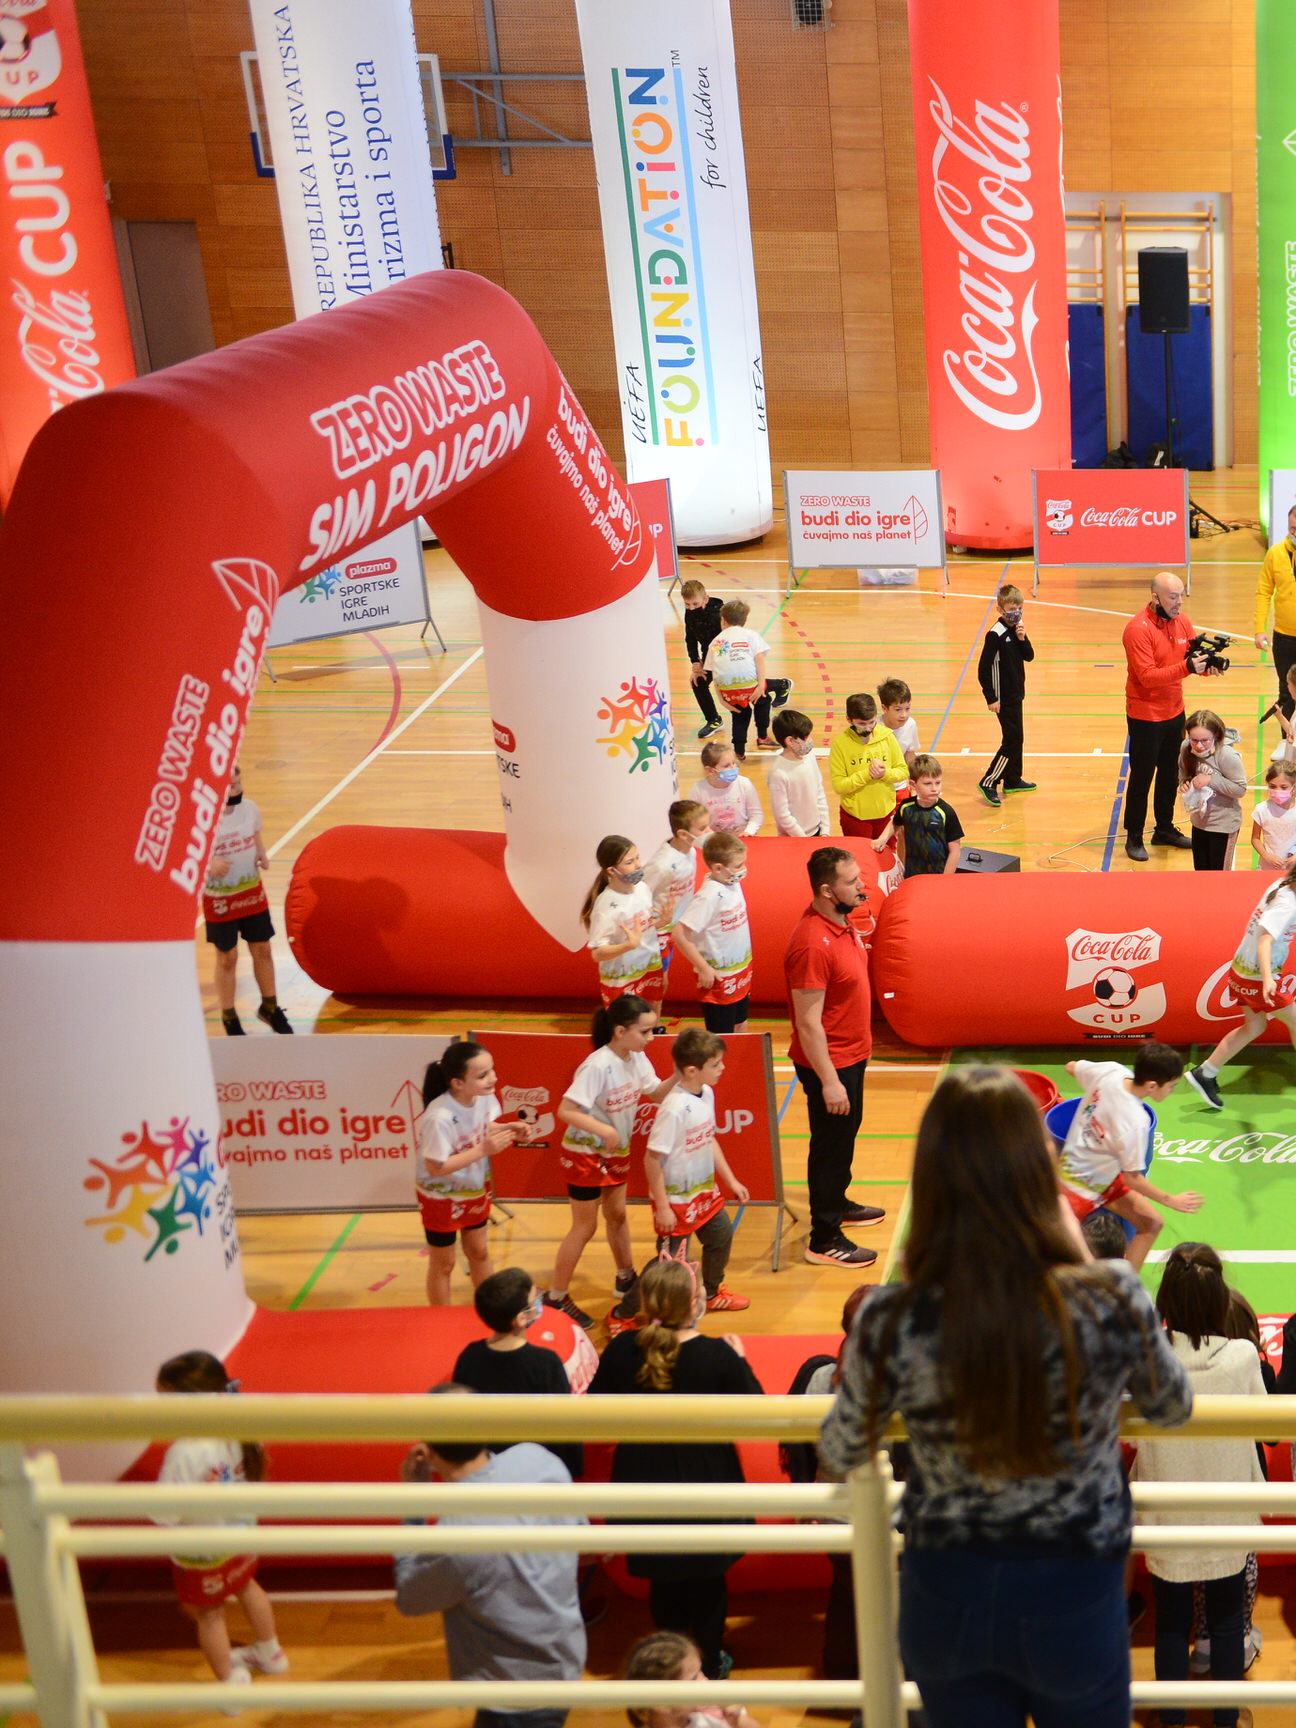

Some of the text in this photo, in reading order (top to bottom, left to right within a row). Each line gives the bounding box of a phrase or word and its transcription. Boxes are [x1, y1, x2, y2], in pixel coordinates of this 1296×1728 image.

[5, 70, 39, 85] UP
[692, 66, 727, 188] for children
[273, 4, 336, 313] REPUBLIKA HRVATSKA
[356, 60, 406, 289] rizma i sporta
[4, 140, 78, 276] CUP
[625, 68, 704, 447] FOUNDATION
[927, 74, 1043, 430] Coca-Cola
[311, 386, 413, 480] ZERO
[395, 340, 505, 435] WASTE
[624, 361, 649, 443] UEFA
[557, 385, 587, 454] budi
[588, 446, 607, 488] dio
[608, 474, 632, 531] igre
[300, 479, 376, 571] SIM
[378, 395, 530, 528] POLIGON
[547, 424, 583, 488] čuvajmo
[579, 484, 600, 514] naš
[591, 509, 626, 555] planet
[800, 495, 870, 507] ZERO WASTE
[801, 511, 911, 530] budi dio igre
[1080, 507, 1177, 527] Coca-Cola CUP
[802, 530, 911, 542] čuvajmo naš planet
[349, 562, 391, 578] plazma
[340, 578, 400, 597] SPORTSKE
[341, 596, 368, 609] IGRE
[343, 605, 389, 621] MLADIH
[171, 604, 263, 894] budi dio igre
[134, 675, 209, 872] ZERO WASTE
[1072, 935, 1157, 961] Coca-Cola
[1093, 1014, 1140, 1024] CUP
[249, 1080, 326, 1100] WASTE
[222, 1106, 406, 1141] udi dio igre
[715, 1109, 754, 1134] UP
[295, 1145, 332, 1161] naš
[340, 1143, 408, 1165] planet
